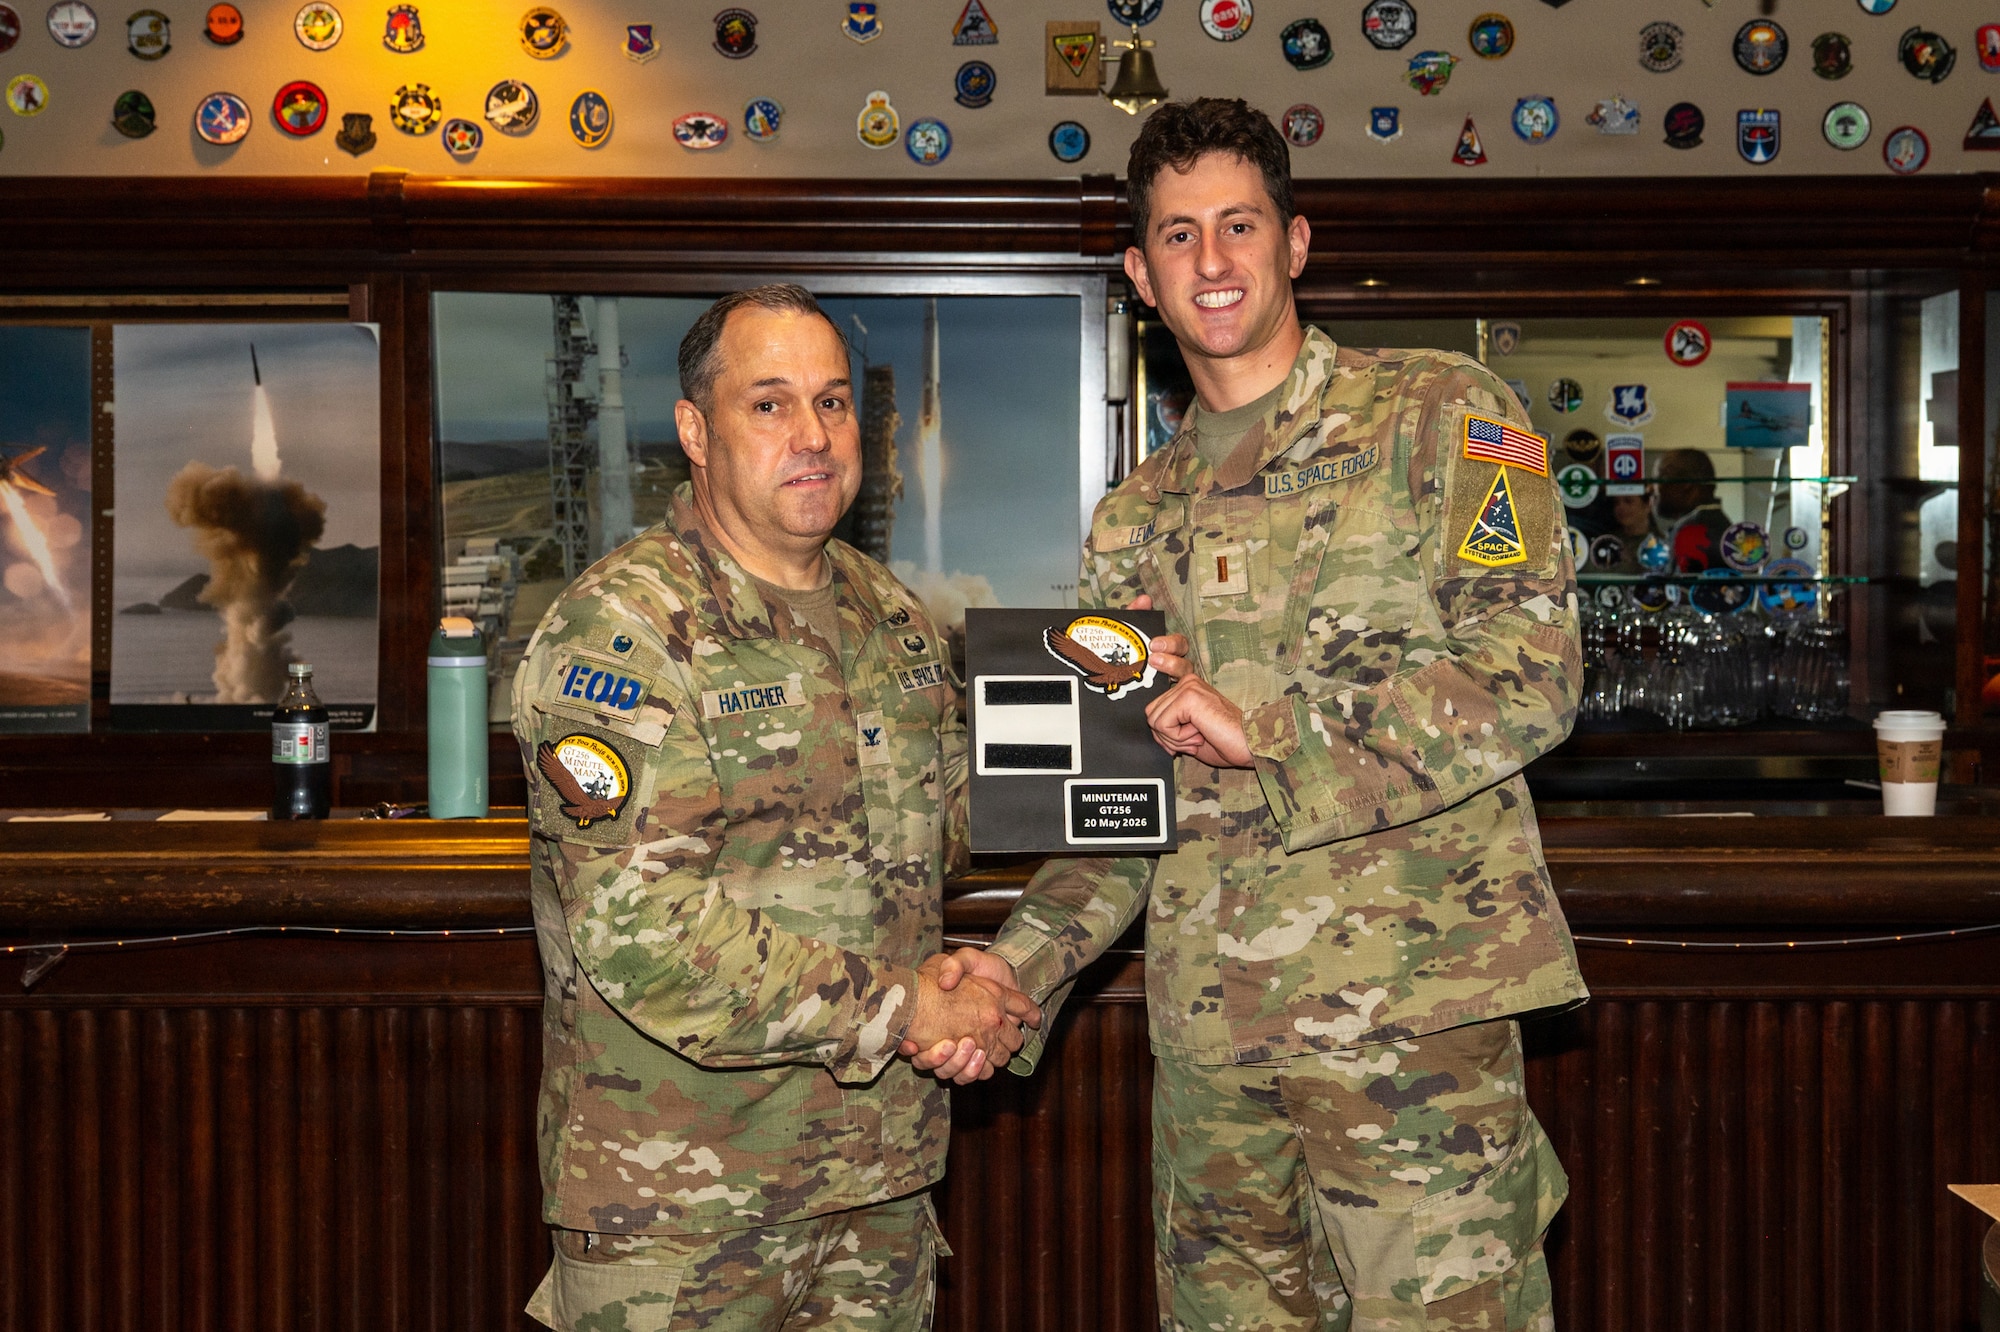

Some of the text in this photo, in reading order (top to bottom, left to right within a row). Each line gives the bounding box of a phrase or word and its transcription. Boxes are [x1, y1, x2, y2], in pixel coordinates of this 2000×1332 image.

[1213, 6, 1240, 23] easy
[1268, 446, 1376, 494] U.S. SPACE FORCE
[1477, 543, 1509, 552] SPACE
[1464, 548, 1521, 562] SYSTEMS COMMAND
[1090, 642, 1114, 650] MAN
[562, 665, 642, 711] EOD
[718, 686, 788, 714] HATCHER
[564, 756, 604, 771] MINUTE
[573, 767, 597, 778] MAN
[1081, 793, 1148, 802] MINUTEMAN
[1099, 806, 1131, 815] GT256
[1084, 818, 1147, 829] 20 May 2026
